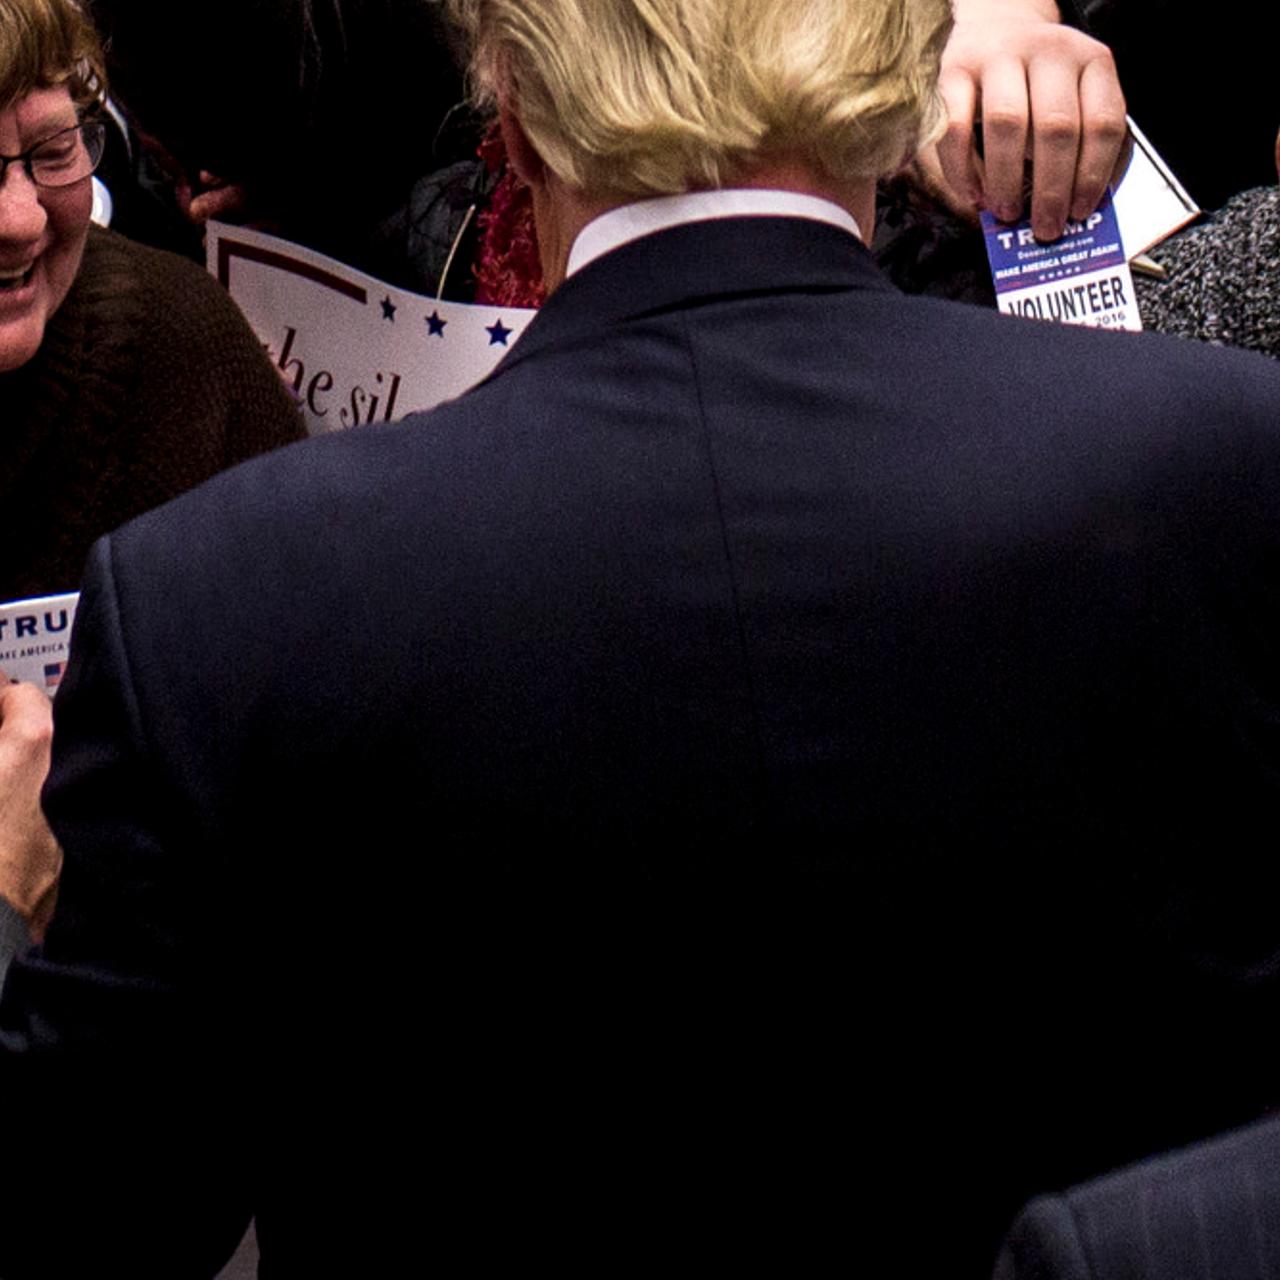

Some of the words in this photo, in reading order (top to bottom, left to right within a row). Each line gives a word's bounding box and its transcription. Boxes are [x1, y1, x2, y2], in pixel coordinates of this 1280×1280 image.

[1021, 258, 1061, 274] AMERICA
[1061, 250, 1089, 266] GREAT
[1008, 276, 1127, 322] VOLUNTEER
[275, 325, 334, 418] he
[338, 370, 402, 428] sil
[21, 642, 65, 657] AMERICA
